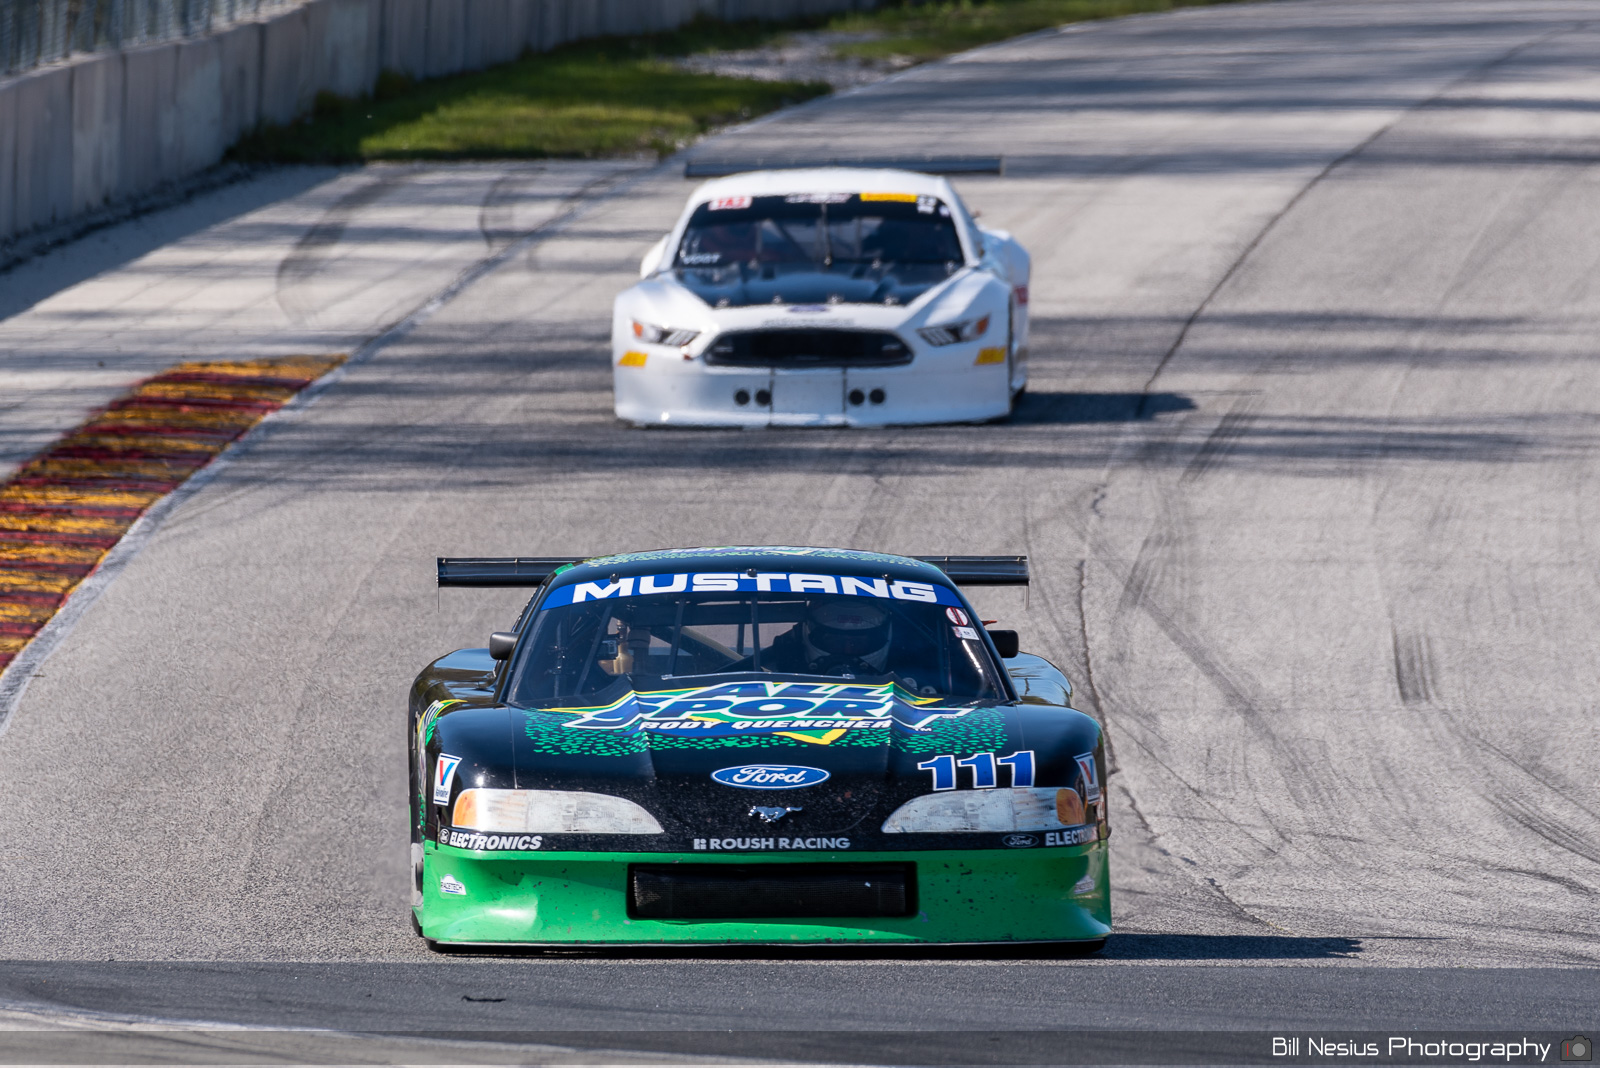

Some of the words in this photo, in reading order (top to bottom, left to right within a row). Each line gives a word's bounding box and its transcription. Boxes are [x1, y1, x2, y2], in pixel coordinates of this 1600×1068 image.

[571, 572, 938, 604] MUSTANG
[561, 693, 976, 730] SPORT
[638, 721, 719, 731] BODY
[731, 720, 893, 730] QUENCHER
[732, 767, 808, 784] Ford
[917, 750, 1036, 791] 111
[449, 831, 543, 851] ELECTRONICS
[710, 838, 775, 850] ROUSH
[778, 837, 851, 850] RACING
